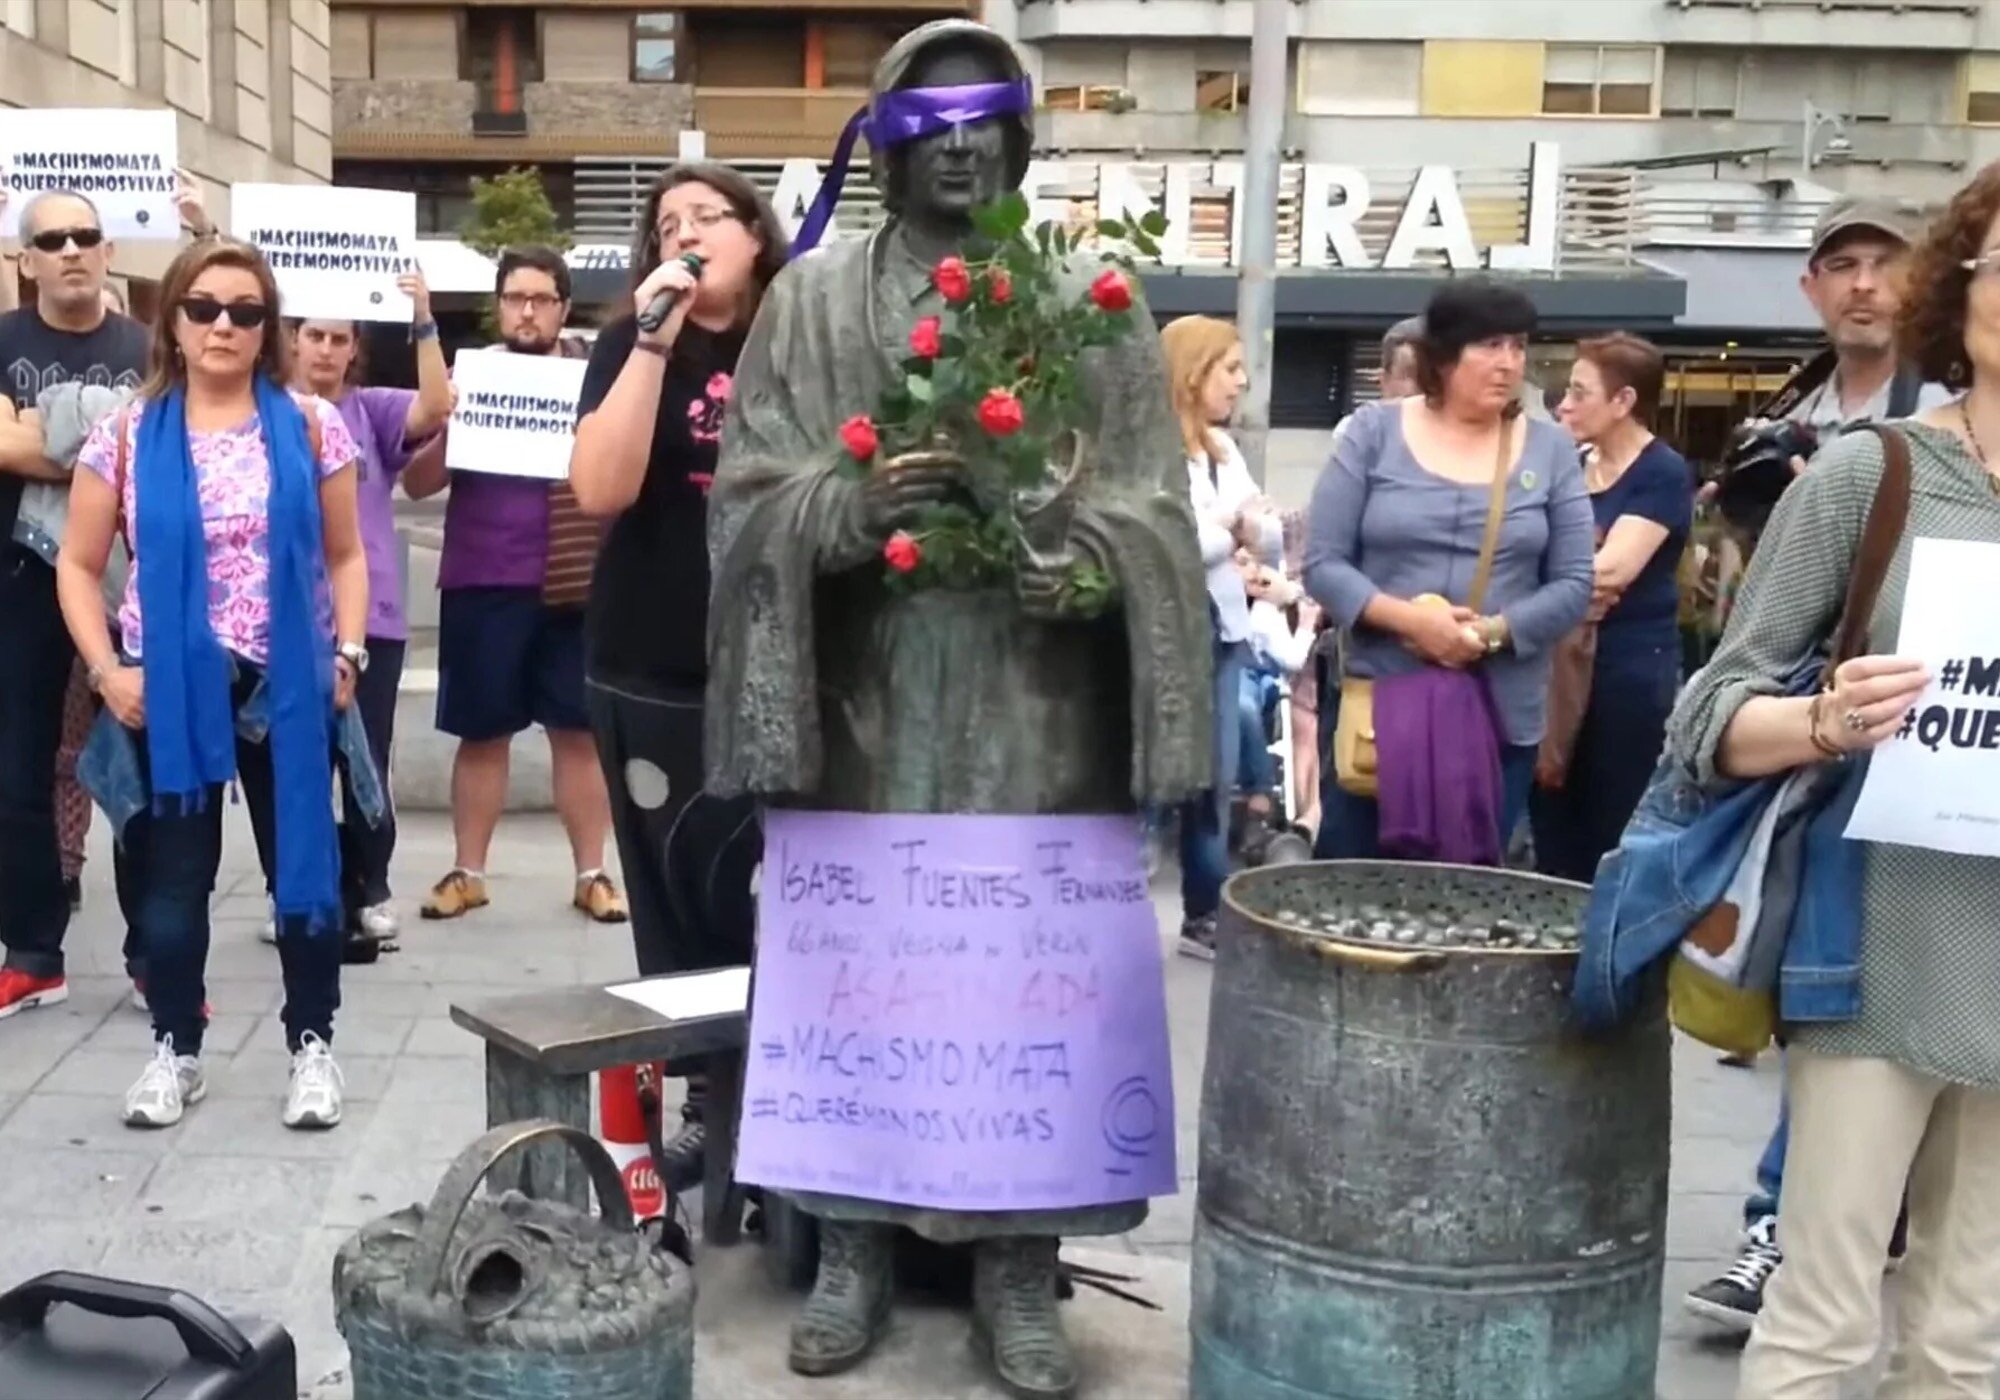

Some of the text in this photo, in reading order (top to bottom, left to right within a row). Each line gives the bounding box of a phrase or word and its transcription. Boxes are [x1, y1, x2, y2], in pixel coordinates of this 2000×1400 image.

[13, 152, 161, 171] #MACHISMOMATA
[1024, 140, 1560, 271] ENTRAL
[250, 229, 398, 252] #MACHISMOMATA
[1940, 655, 2000, 697] #M
[780, 838, 875, 904] ISABEL
[891, 839, 1031, 908] FUENTES
